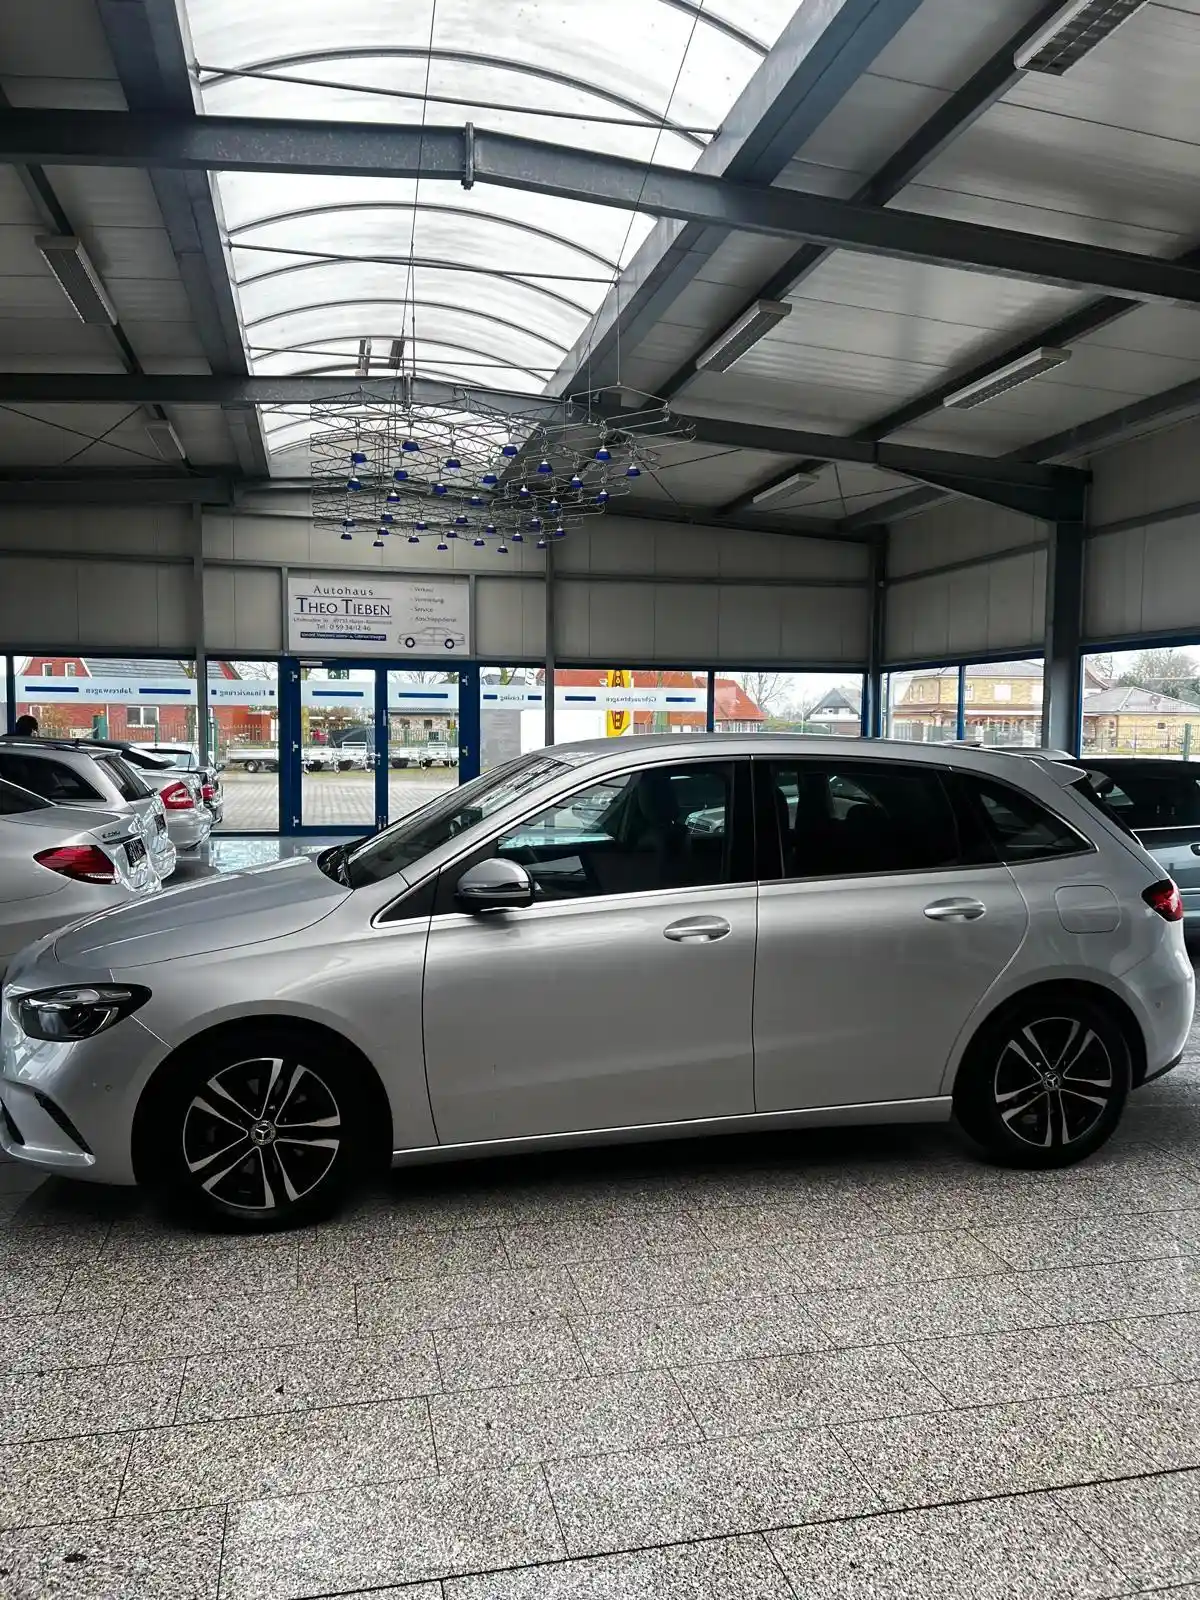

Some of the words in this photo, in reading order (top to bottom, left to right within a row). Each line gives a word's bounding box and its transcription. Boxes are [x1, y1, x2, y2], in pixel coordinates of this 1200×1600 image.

[313, 585, 374, 596] Autohaus
[296, 597, 338, 614] THEO
[340, 599, 390, 616] TIEBEN
